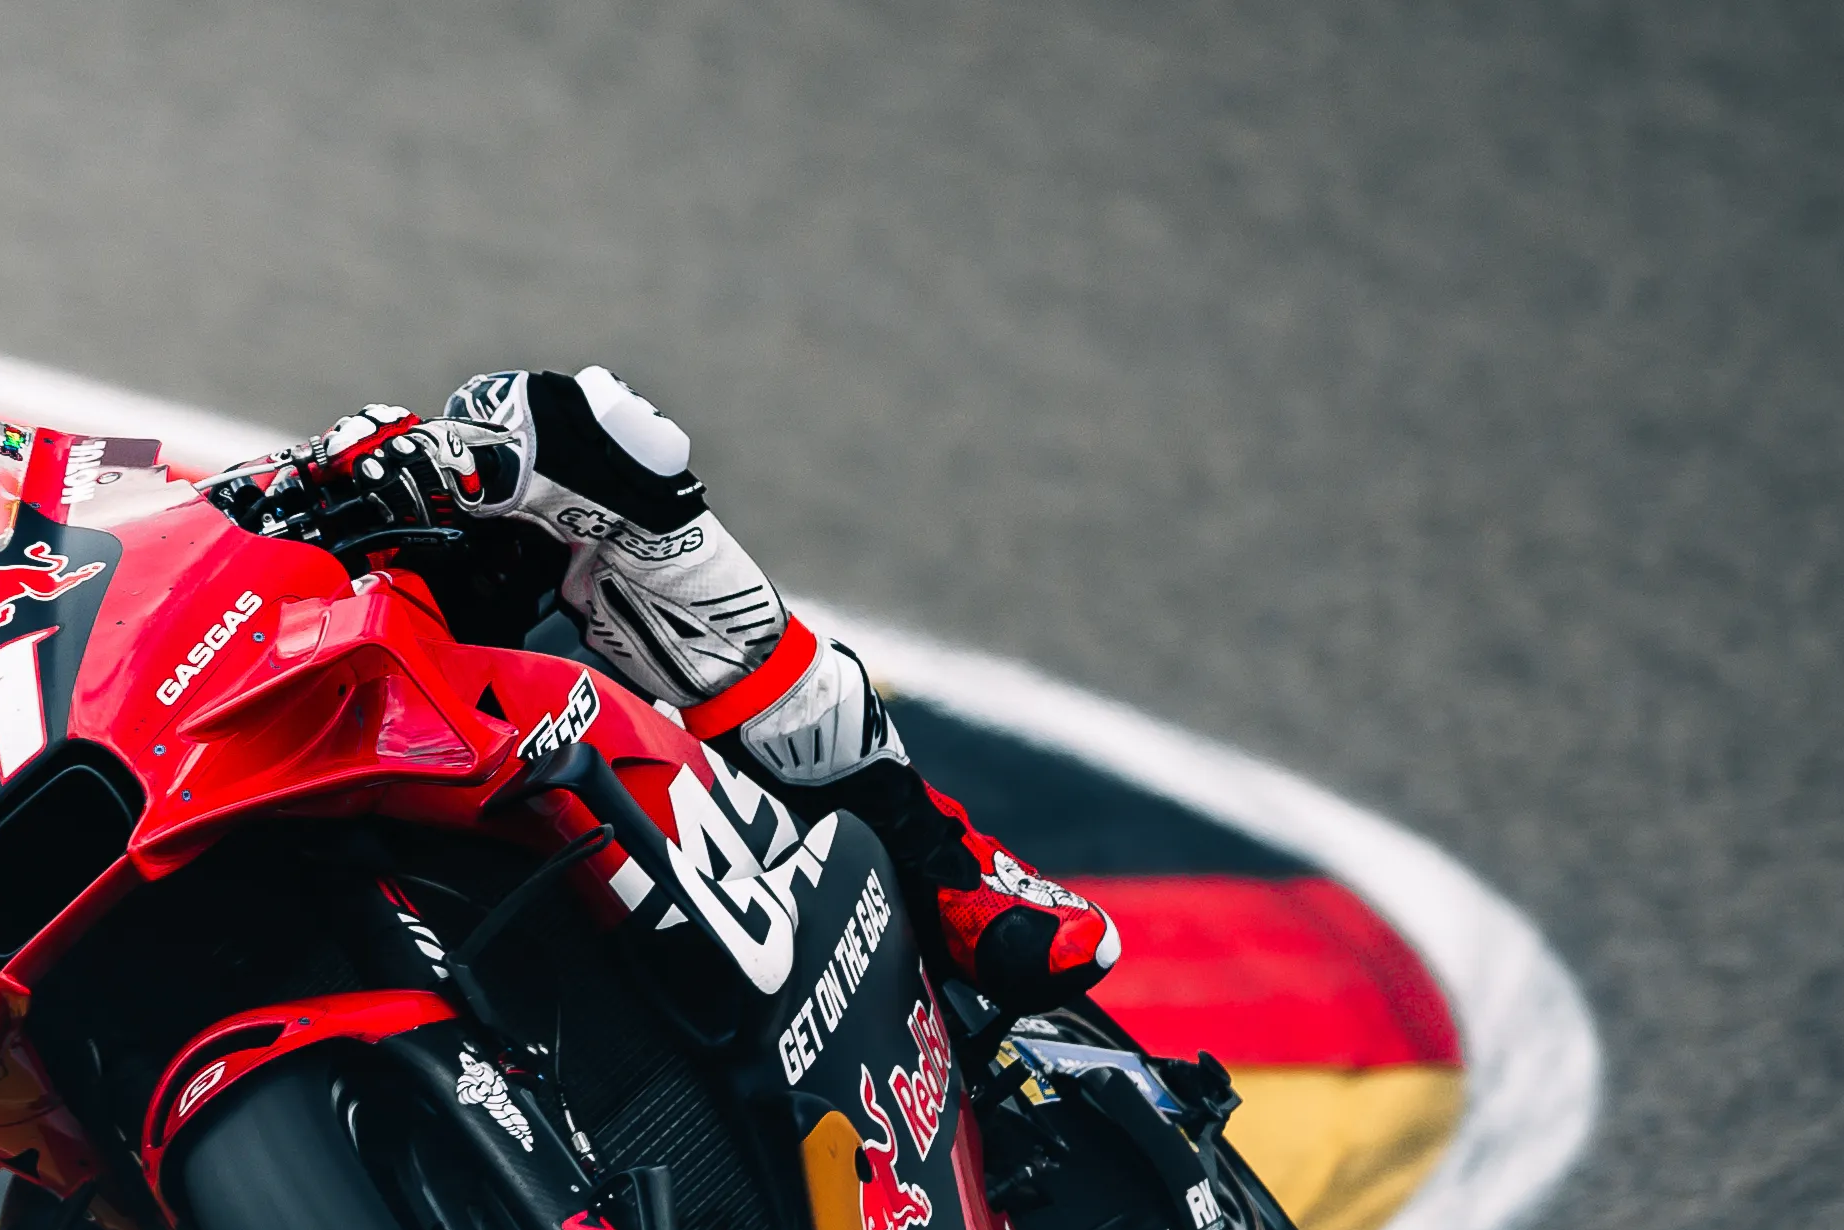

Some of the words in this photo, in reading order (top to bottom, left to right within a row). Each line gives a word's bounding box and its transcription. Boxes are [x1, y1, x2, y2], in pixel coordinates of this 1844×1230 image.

[61, 441, 107, 504] MOTUL
[156, 590, 263, 706] GASGAS
[778, 997, 823, 1086] GET
[815, 960, 848, 1033] ON
[835, 917, 870, 994] THE
[856, 868, 891, 953] GAS!
[1186, 1178, 1223, 1230] RK
